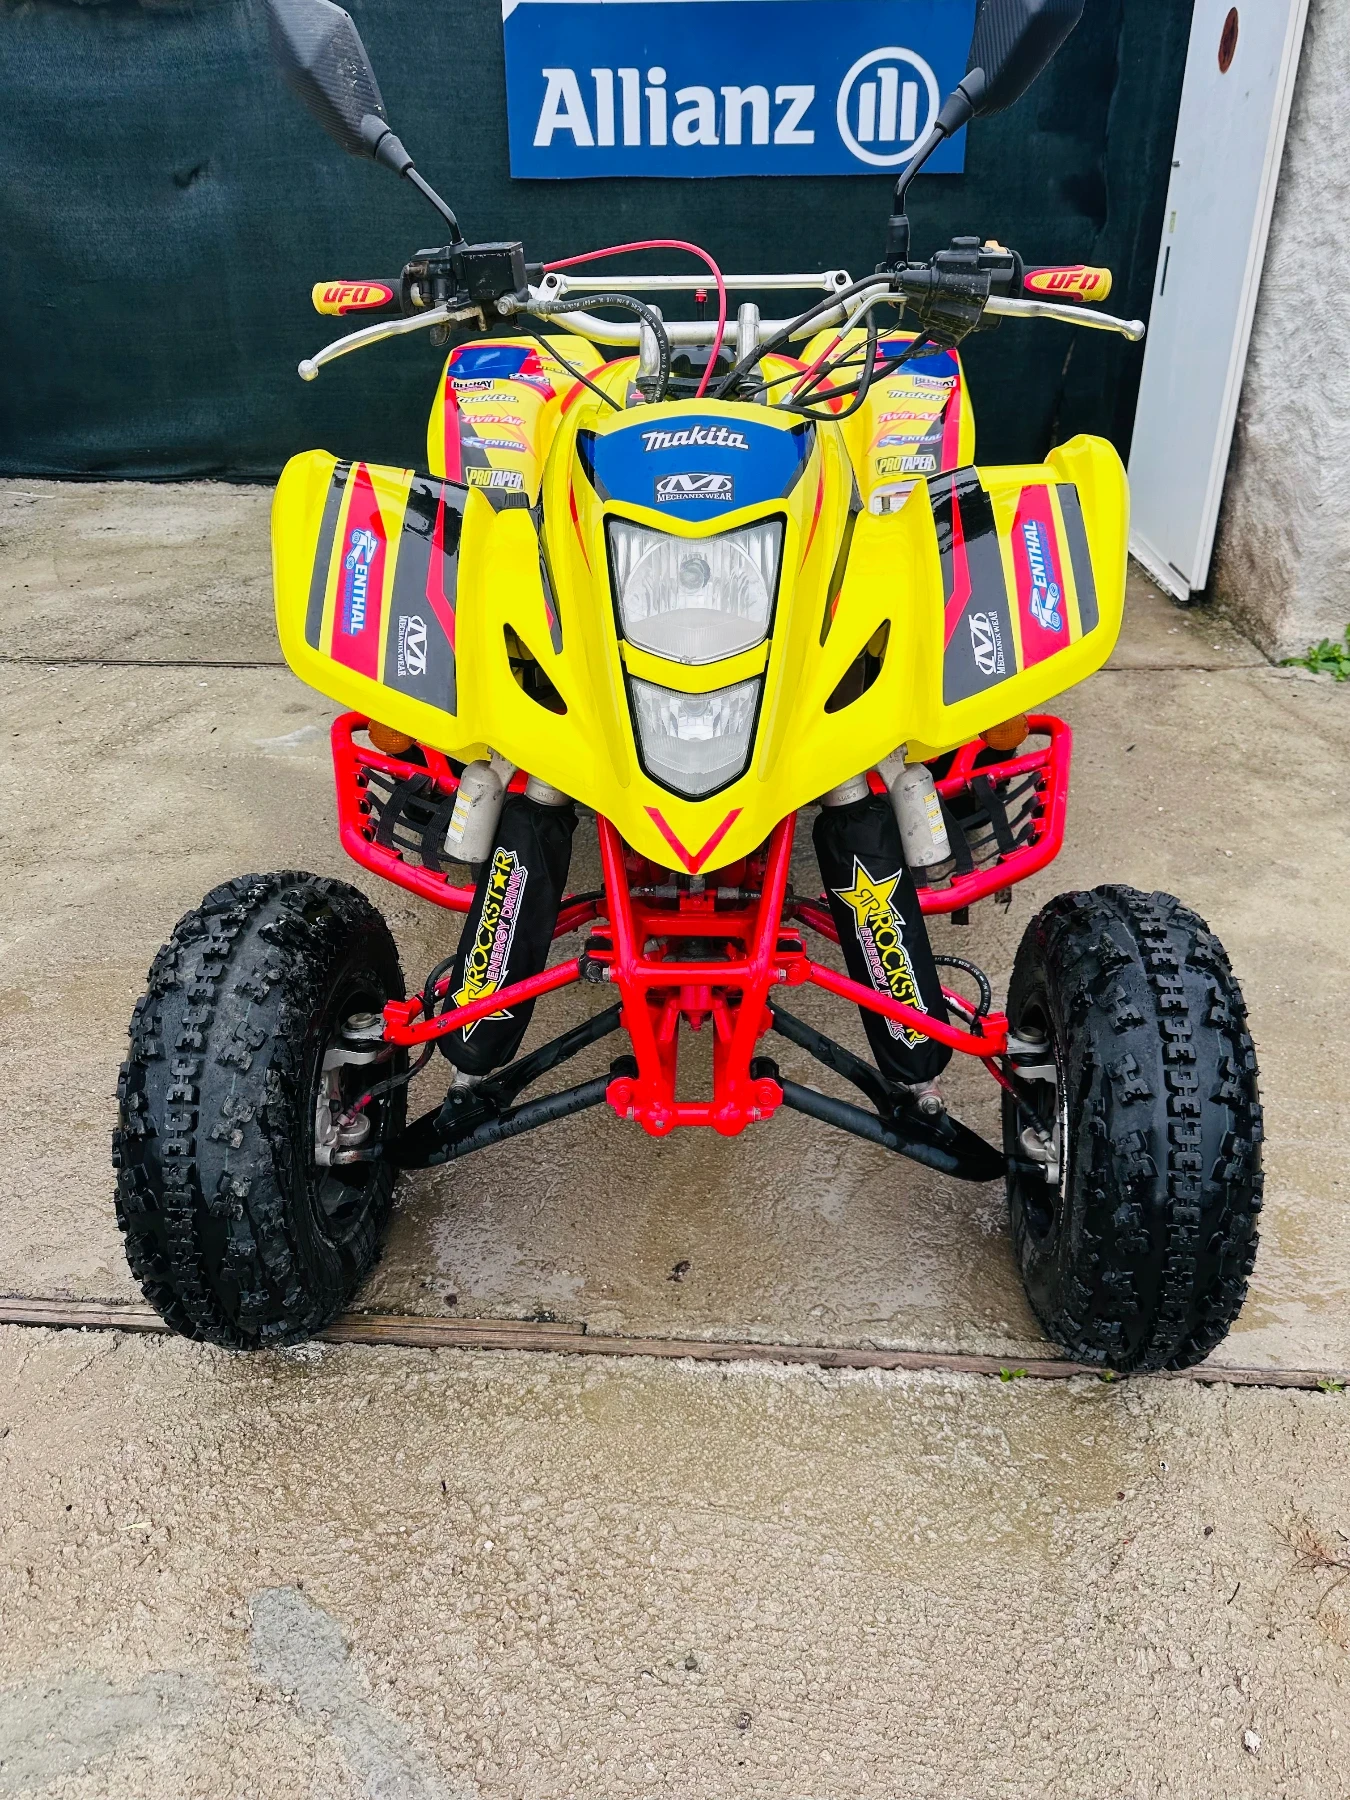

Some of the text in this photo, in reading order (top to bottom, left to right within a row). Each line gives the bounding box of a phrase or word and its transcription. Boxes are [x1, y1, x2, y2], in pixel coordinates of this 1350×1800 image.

[533, 66, 815, 146] Allianz
[460, 414, 526, 426] Twin Air
[878, 411, 942, 424] Twin Air
[469, 469, 523, 488] PROTAPER
[656, 490, 732, 502] MECHANIX WEAR
[398, 615, 408, 677] MECHANIX WEAR
[988, 610, 1006, 675] MECHANIX WEAR
[486, 870, 523, 982] ENERGY DRINK
[859, 927, 889, 988] ENERGY
